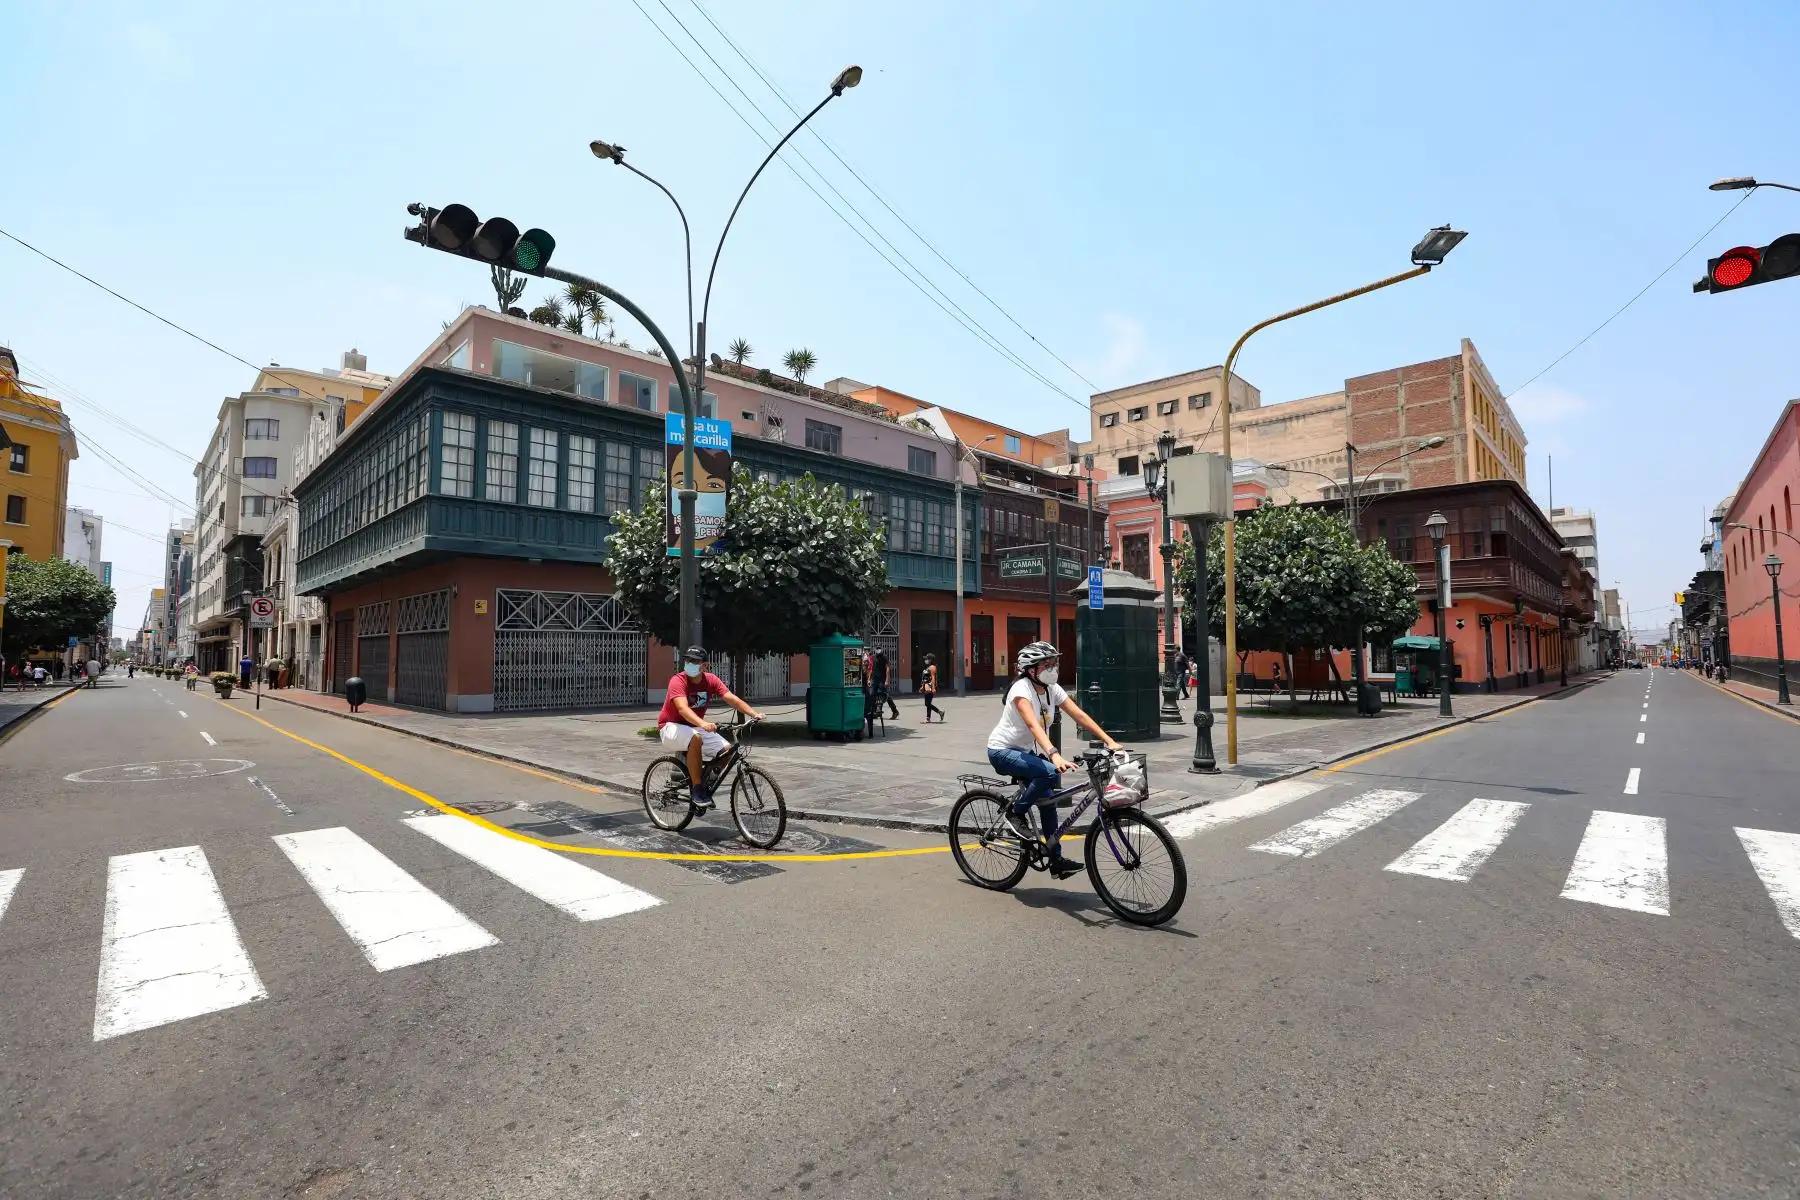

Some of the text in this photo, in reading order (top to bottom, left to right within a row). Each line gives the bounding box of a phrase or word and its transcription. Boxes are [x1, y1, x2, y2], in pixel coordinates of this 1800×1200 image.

[707, 423, 718, 433] tu
[670, 431, 729, 447] macarilla
[1003, 562, 1011, 570] JR.
